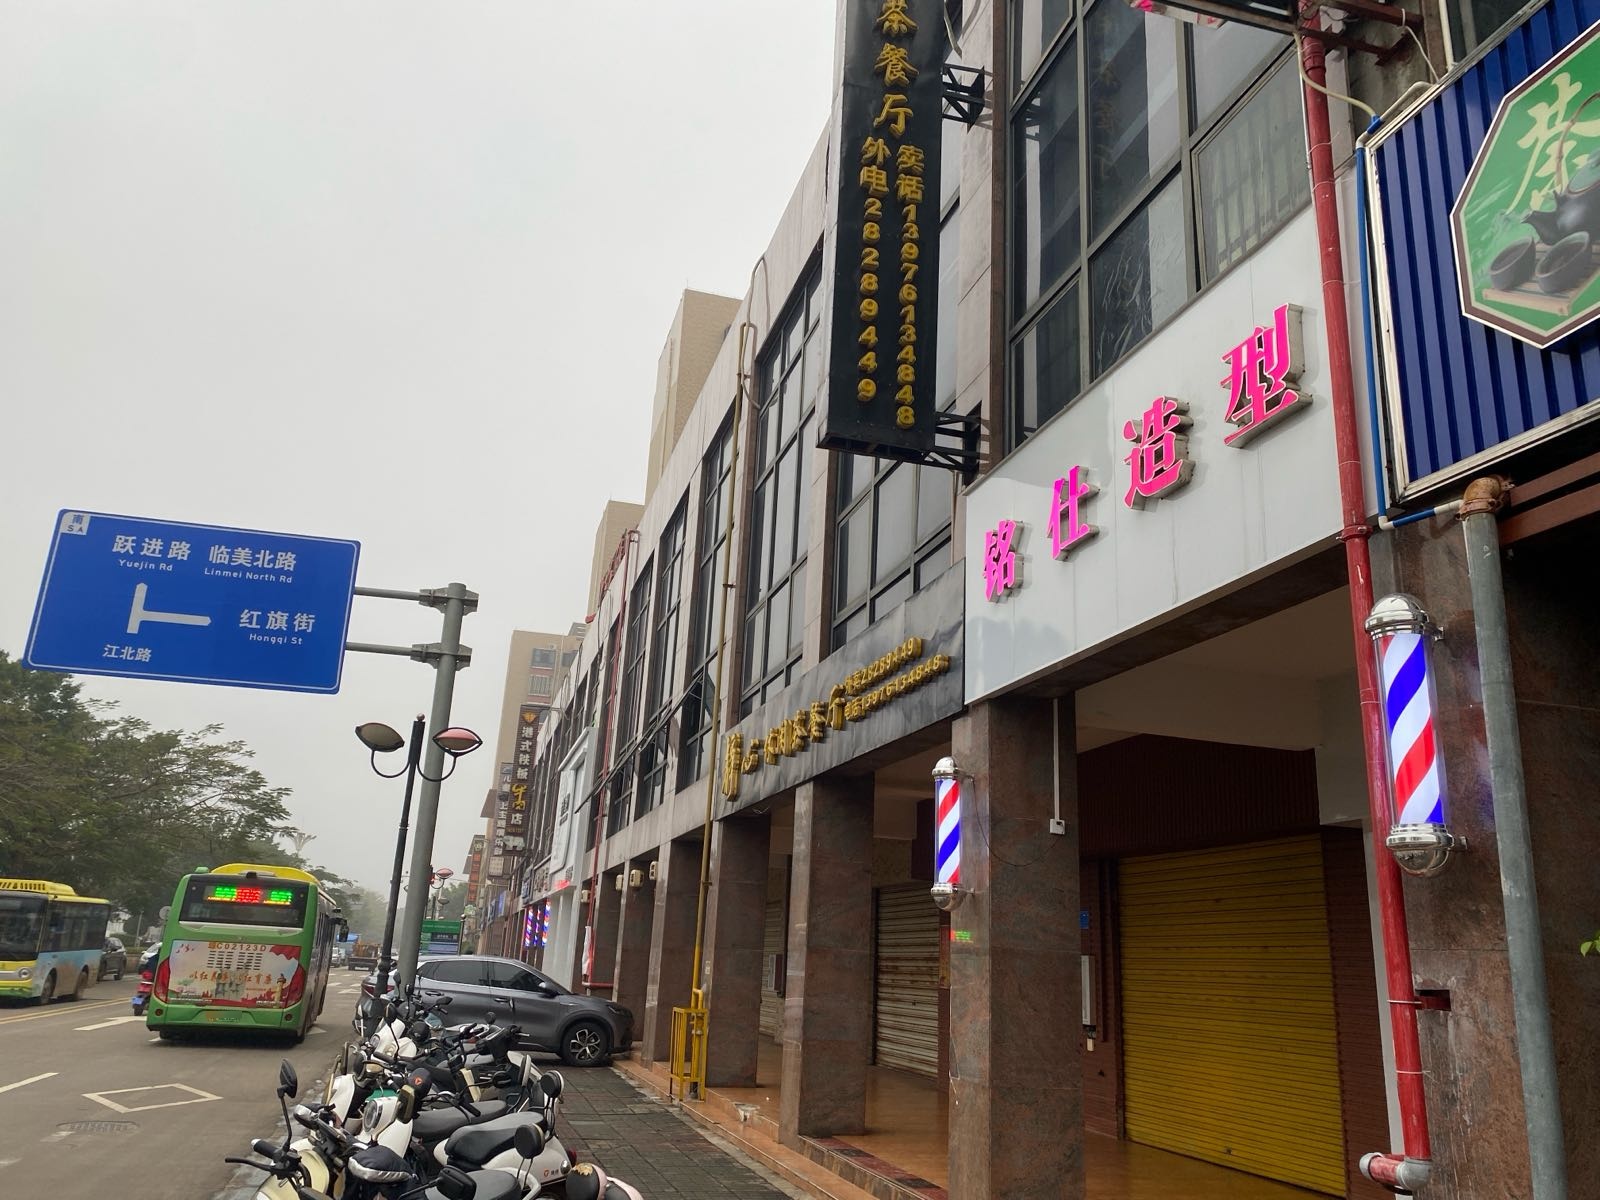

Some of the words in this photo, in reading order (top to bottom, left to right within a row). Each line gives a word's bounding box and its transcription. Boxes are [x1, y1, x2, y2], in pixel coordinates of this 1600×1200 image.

[874, 0, 919, 139] 茶餐厅
[983, 303, 1306, 602] 铭仕造型
[72, 514, 84, 524] 南
[112, 535, 191, 561] 跃进路
[208, 544, 297, 571] 临美北路
[119, 559, 156, 571] Yuejin
[159, 562, 173, 571] Rd
[204, 567, 242, 579] Linmei
[245, 571, 276, 582] North
[279, 575, 293, 584] Rd
[239, 609, 316, 633] 红旗街
[249, 633, 288, 645] Hongqi
[291, 637, 303, 645] St
[102, 644, 152, 662] 江北路
